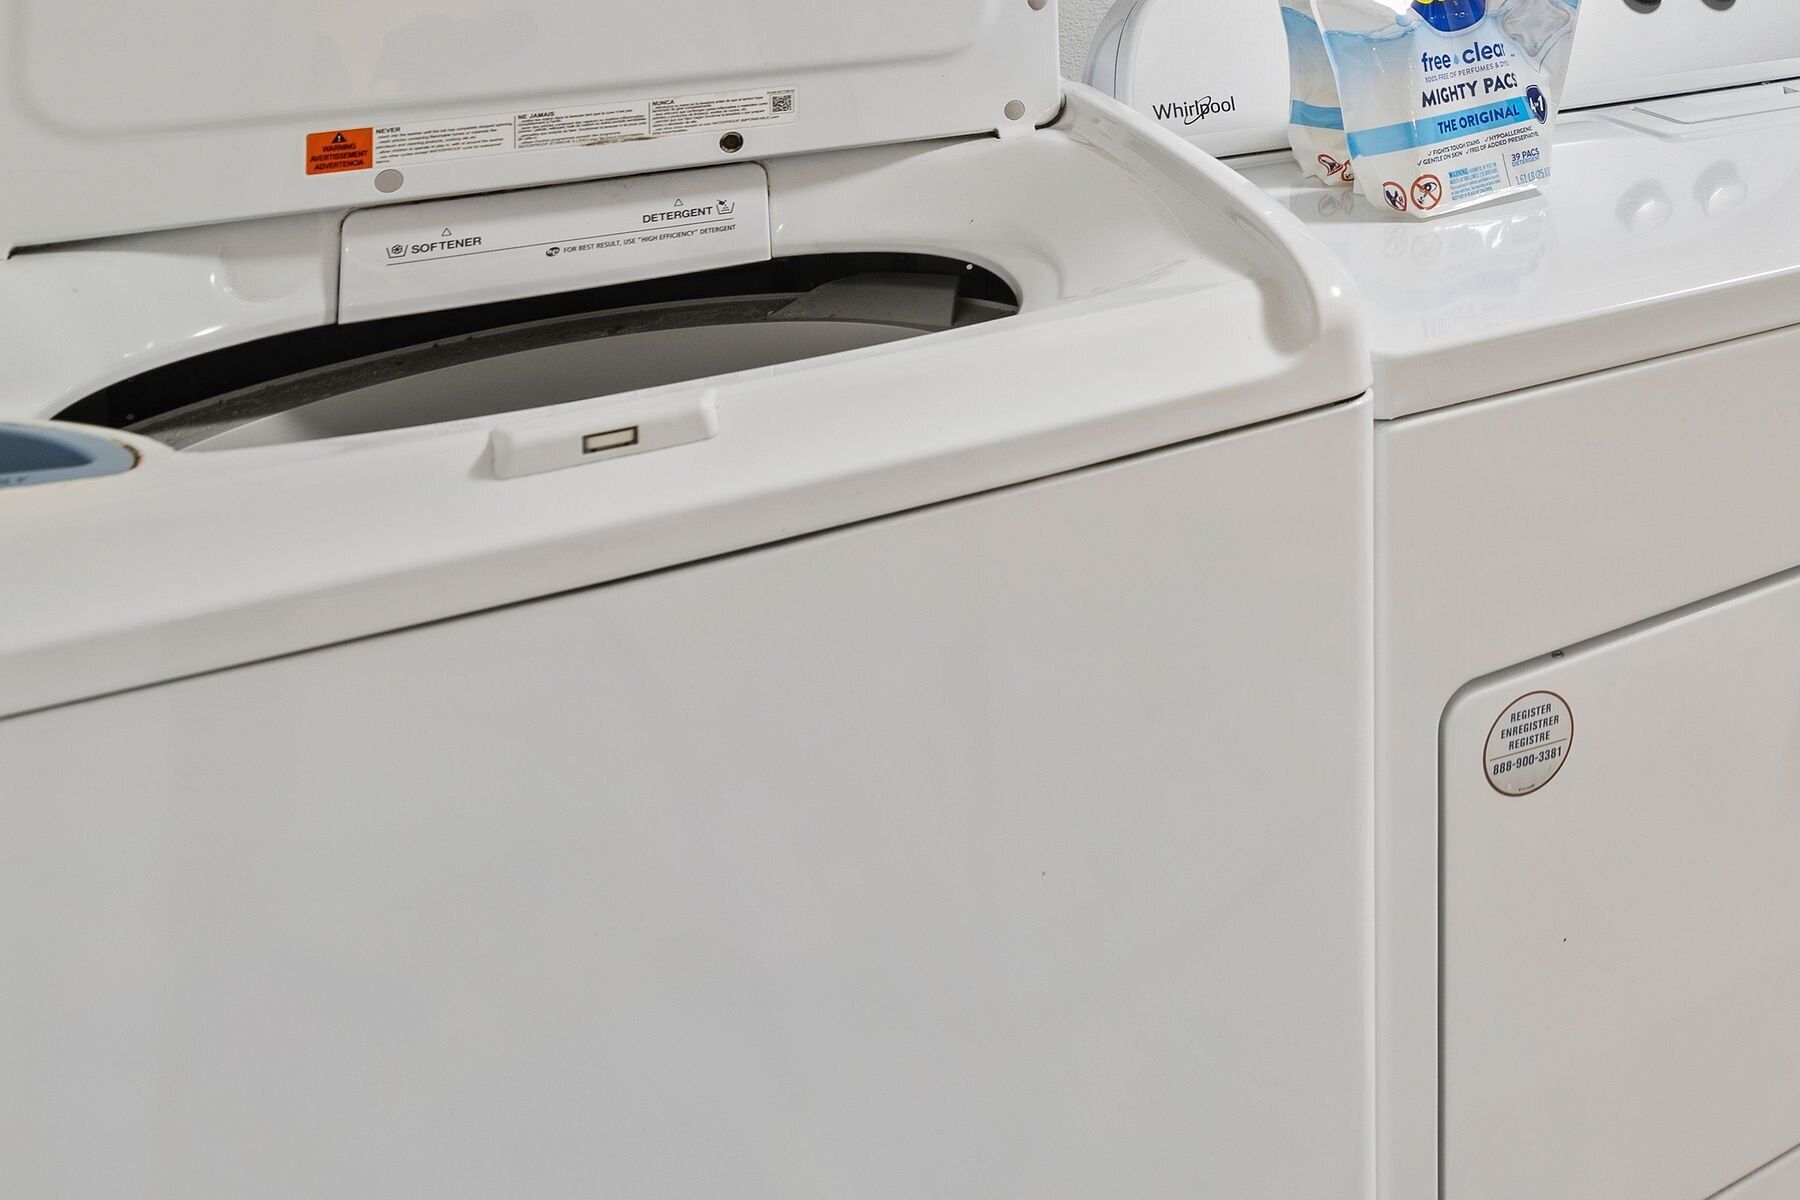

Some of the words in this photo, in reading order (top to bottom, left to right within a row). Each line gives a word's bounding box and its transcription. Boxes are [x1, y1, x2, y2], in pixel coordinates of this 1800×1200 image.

[1421, 52, 1452, 73] free
[1458, 63, 1494, 77] PERFUMES
[1421, 80, 1479, 108] MIGHTY
[1483, 72, 1518, 94] PACS
[529, 111, 555, 119] JAMAIS
[1152, 95, 1236, 126] Whirlpool
[1437, 119, 1458, 134] THE
[1458, 104, 1520, 129] ORIGINAL
[376, 127, 401, 135] NEVER
[1432, 146, 1450, 156] FIGHTS
[1450, 143, 1466, 152] TOUGH
[1466, 139, 1481, 149] STAINS
[1489, 126, 1533, 142] HYPOALLERGENIC
[310, 150, 368, 162] AVERTISSEMENT
[322, 142, 357, 153] WARNING
[1422, 156, 1443, 165] GENTLE
[1451, 151, 1463, 160] SKIN
[1469, 145, 1480, 154] FREE
[1480, 143, 1487, 151] OF
[1487, 139, 1507, 149] ADDED
[1510, 152, 1521, 162] 39
[1521, 147, 1540, 159] PACS
[314, 160, 365, 171] ADVERTENCIA
[642, 206, 713, 224] DETERGENT
[411, 236, 482, 256] SOFTENER
[563, 245, 578, 253] FOR
[578, 243, 595, 252] BEST
[596, 239, 622, 250] RESULT,
[623, 237, 636, 245] USE
[699, 224, 736, 235] DETERGENT
[1510, 703, 1552, 723] REGISTER
[1500, 714, 1560, 739] ENREGISTRER
[1508, 730, 1551, 751] REGISTRE
[1493, 746, 1562, 776] 888-900-3381
